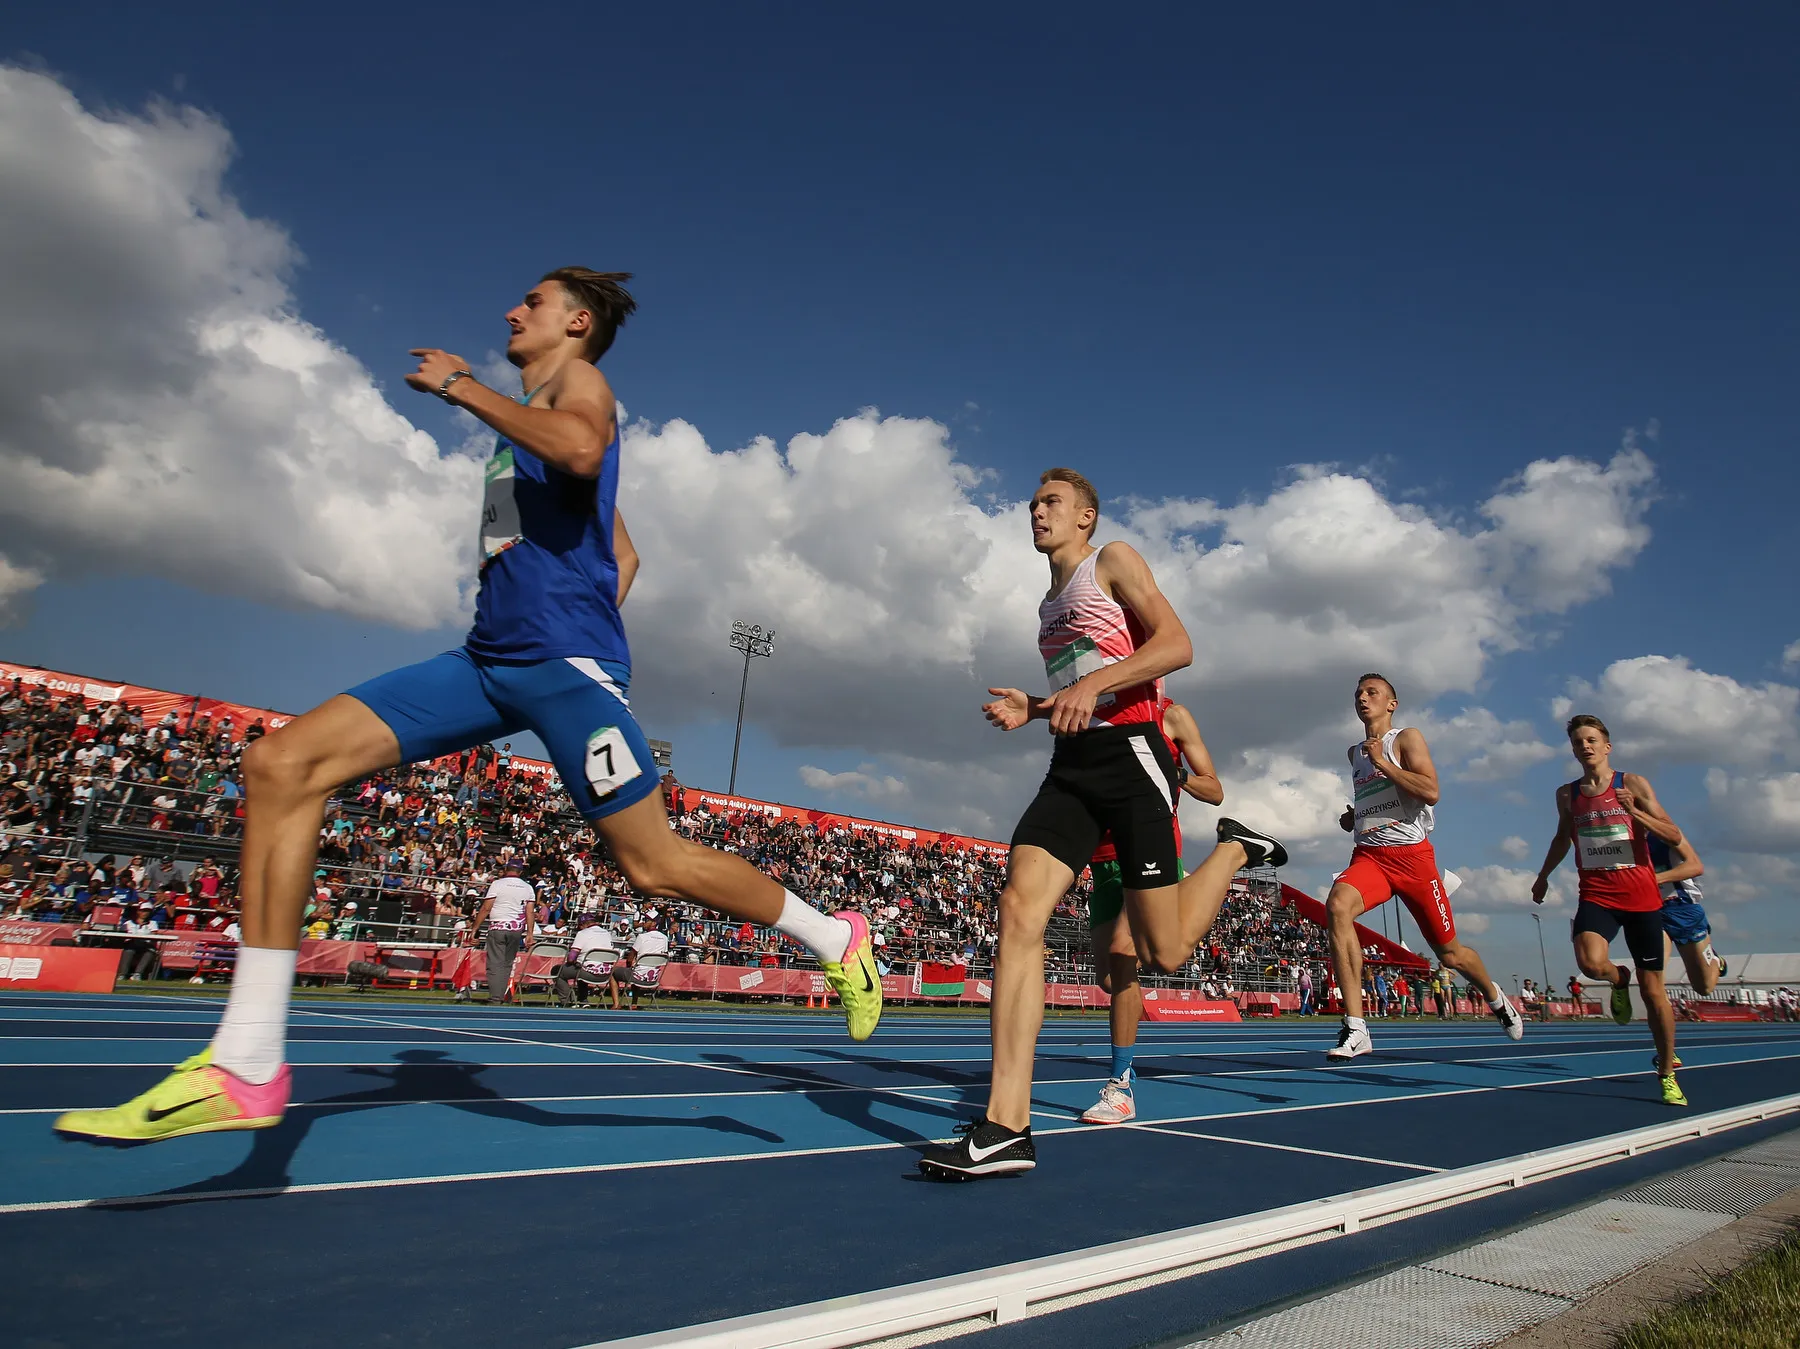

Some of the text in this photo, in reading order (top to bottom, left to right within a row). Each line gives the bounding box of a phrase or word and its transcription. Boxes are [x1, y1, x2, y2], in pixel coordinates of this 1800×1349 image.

[49, 679, 81, 693] 2018
[592, 743, 615, 776] 7
[512, 760, 546, 774] BUENOS
[728, 799, 747, 810] AIRES
[873, 825, 889, 835] AIRES
[1587, 846, 1623, 857] DAVIDIK
[1430, 879, 1450, 932] POLSKA
[1158, 1007, 1174, 1015] Explore
